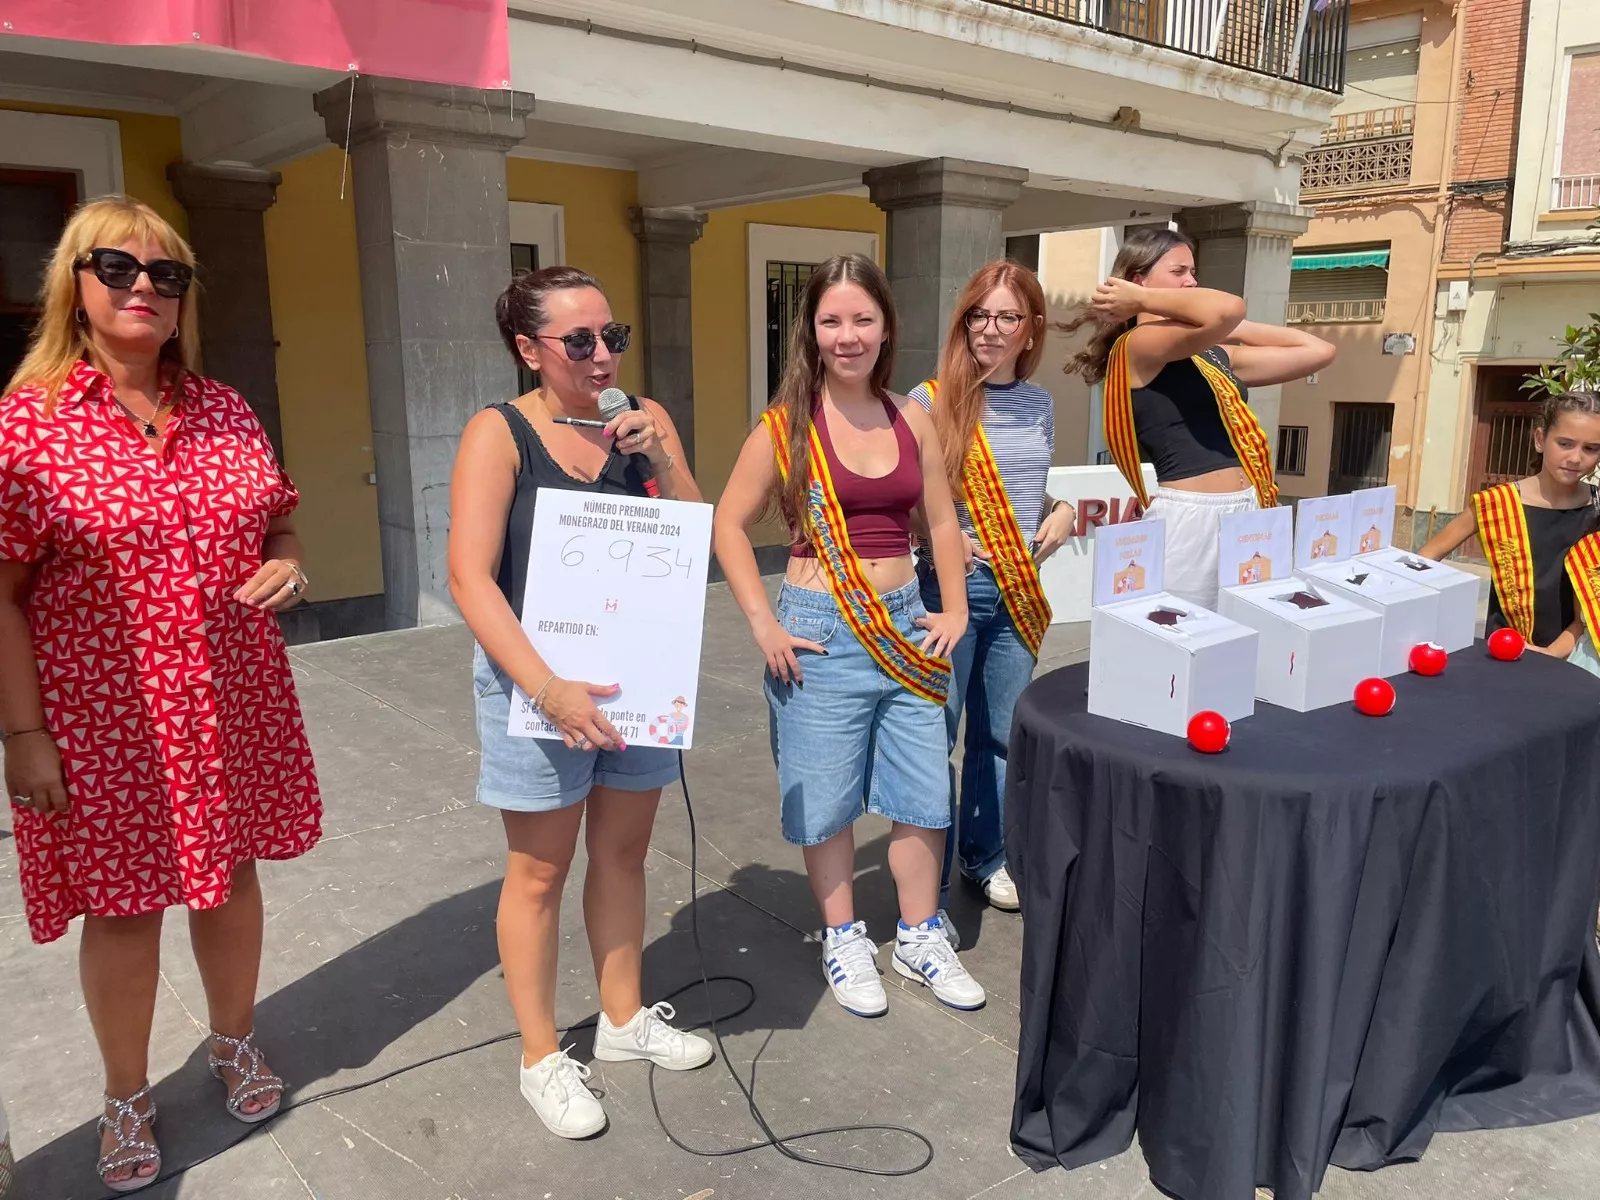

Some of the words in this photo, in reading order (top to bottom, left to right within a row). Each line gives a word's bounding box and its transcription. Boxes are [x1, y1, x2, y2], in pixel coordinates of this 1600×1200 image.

[583, 500, 617, 515] NÚMERO
[619, 505, 660, 519] PREMIADO
[559, 514, 608, 530] MONEGRAZO
[610, 519, 624, 531] DEL
[627, 521, 658, 535] VERANO
[660, 524, 681, 537] 2024
[561, 535, 693, 579] 6.934
[807, 480, 848, 583] Mairalesa
[843, 588, 872, 626] San
[996, 546, 1024, 584] San
[538, 620, 583, 635] REPARTIDO
[585, 624, 599, 637] EN:
[610, 710, 634, 722] ponte
[635, 712, 646, 723] en
[630, 726, 639, 739] 71
